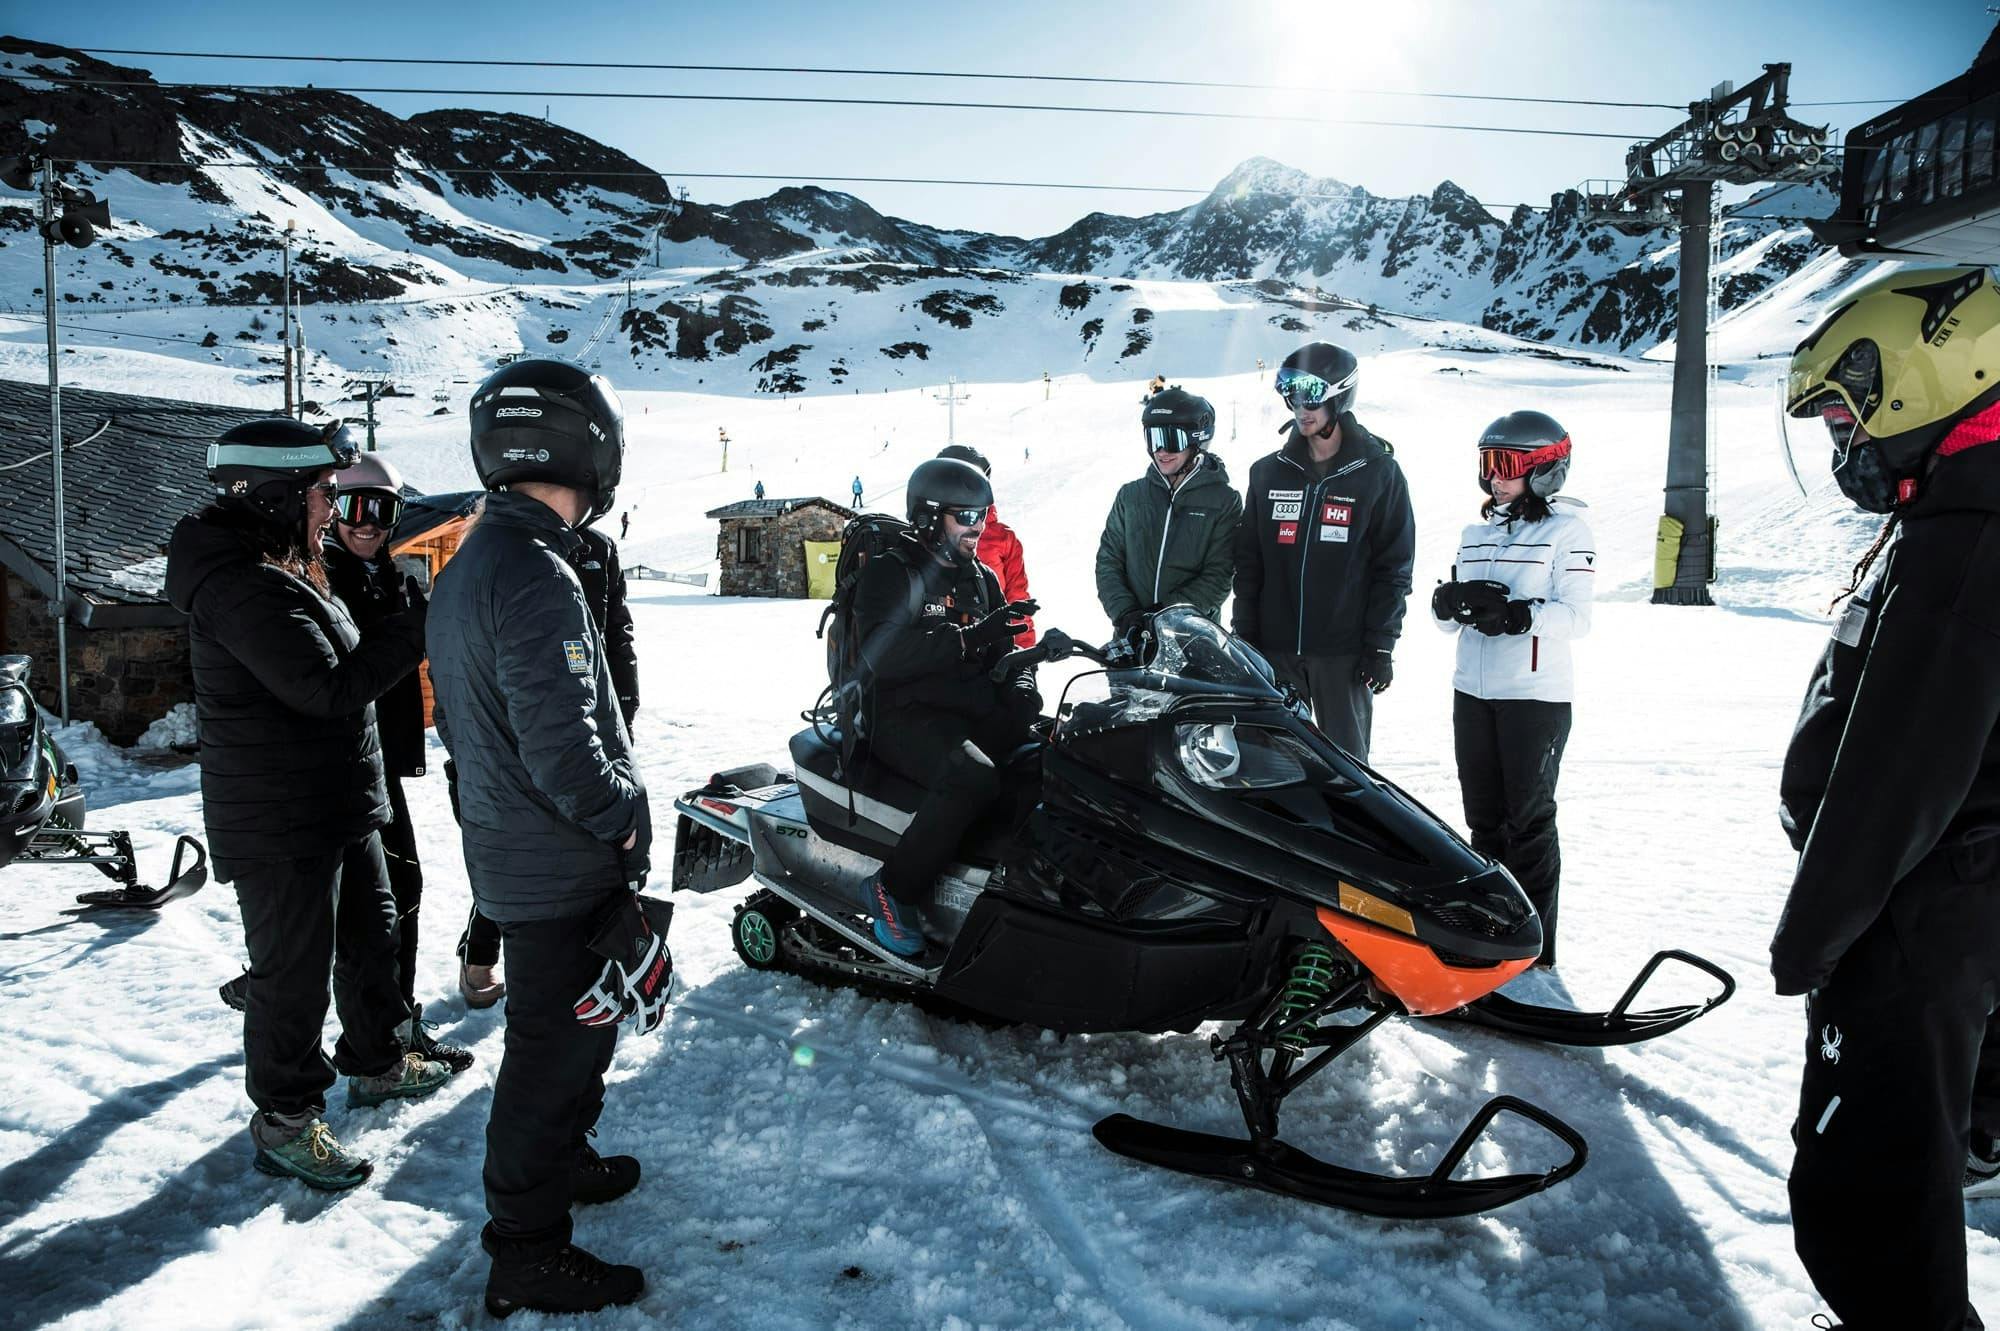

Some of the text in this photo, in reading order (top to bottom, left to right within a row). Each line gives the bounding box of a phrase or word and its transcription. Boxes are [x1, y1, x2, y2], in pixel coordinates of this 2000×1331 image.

[1326, 508, 1348, 521] HH
[1280, 527, 1295, 537] infor
[776, 825, 808, 839] 570
